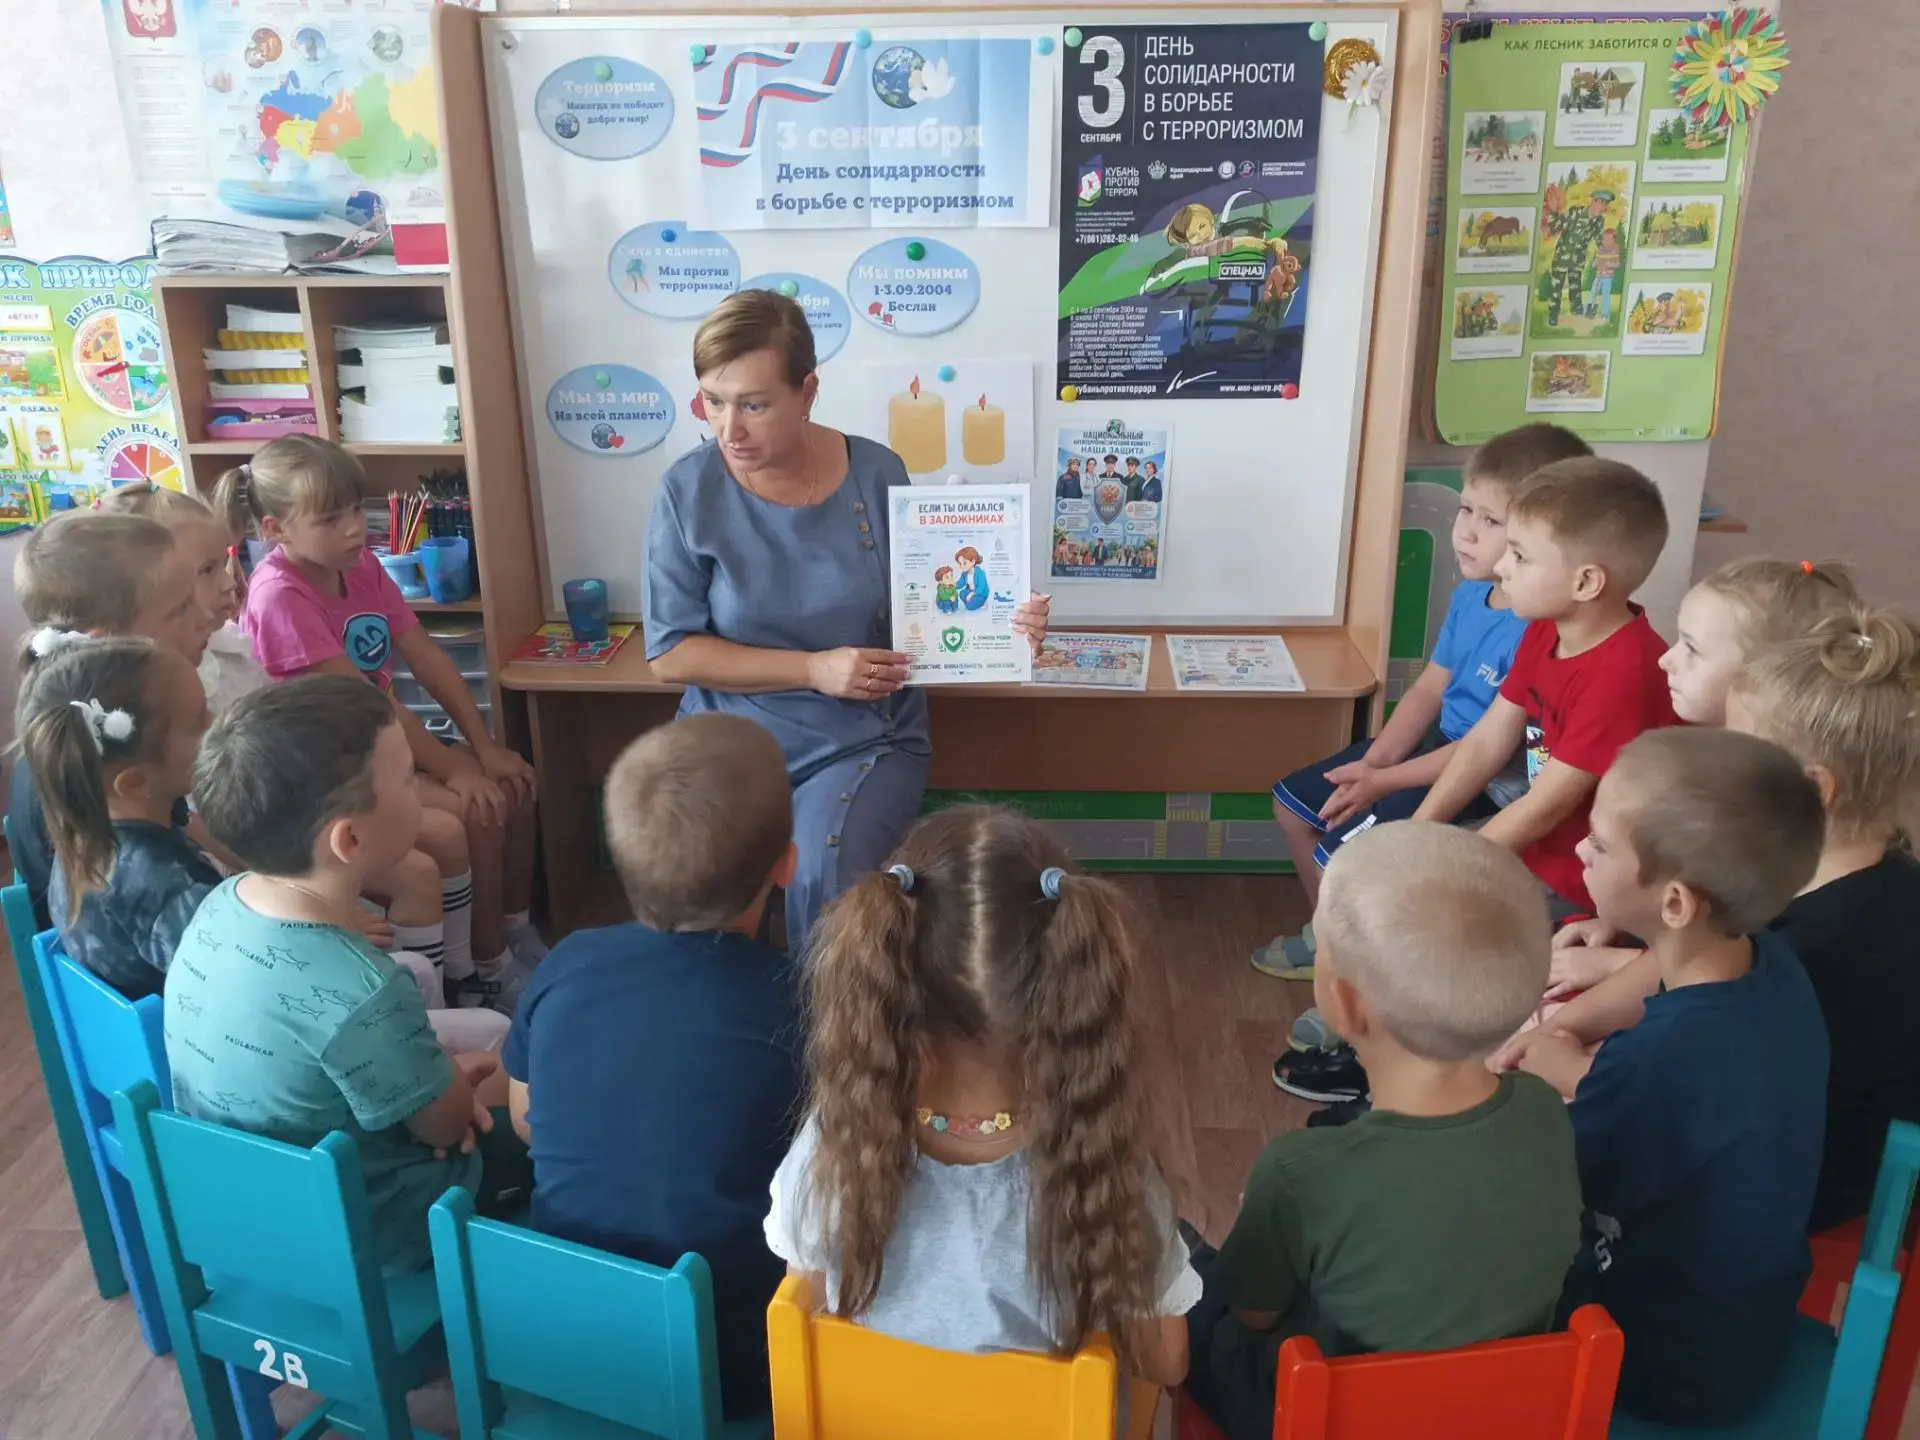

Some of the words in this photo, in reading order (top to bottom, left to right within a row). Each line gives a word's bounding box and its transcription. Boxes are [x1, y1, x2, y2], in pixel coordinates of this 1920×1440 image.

[1145, 36, 1194, 58] ДЕНЬ
[1504, 40, 1529, 50] КАК
[1534, 39, 1584, 50] ЛЕСНИК
[1588, 37, 1659, 49] ЗАБОТИТСЯ
[1662, 38, 1671, 48] О
[1144, 63, 1295, 86] СОЛИДАРНОСТИ
[563, 80, 656, 96] Терроризм
[1078, 36, 1125, 128] 3
[1144, 93, 1155, 112] В
[1161, 92, 1234, 112] БОРЬБЕ
[586, 114, 617, 125] добро
[626, 114, 649, 125] мир!
[1143, 121, 1154, 141] С
[1160, 119, 1304, 141] ТЕРРОРИЗМОМ
[776, 122, 797, 149] 3
[808, 117, 983, 157] сентября
[1080, 133, 1122, 143] СЕНТЯБРЯ
[776, 163, 830, 183] День
[836, 162, 986, 182] солидарности
[1105, 167, 1139, 176] КУБАНЬ
[1105, 177, 1139, 186] ПРОТИВ
[1105, 188, 1138, 196] ТЕРРОРА
[756, 197, 766, 210] в
[771, 192, 847, 215] борьбе
[853, 196, 865, 209] с
[870, 194, 1014, 214] терроризмом
[658, 266, 680, 276] Мы
[683, 267, 729, 279] против
[858, 266, 888, 280] Мы
[894, 267, 968, 281] помним
[1220, 265, 1264, 277] СПЕЦНАЗ
[659, 281, 733, 292] терроризма!
[874, 284, 952, 296] 1-3.09.2004
[67, 294, 116, 327] ВРЕМЯ
[124, 295, 160, 325] ГОД
[888, 301, 936, 312] Беслан
[558, 390, 590, 404] Мы
[596, 392, 616, 403] за
[621, 392, 659, 407] мир
[554, 411, 572, 421] На
[575, 410, 606, 421] всей
[609, 410, 667, 421] планете!
[1081, 446, 1107, 454] НАША
[1110, 446, 1144, 455] ЗАЩИТА
[919, 504, 940, 513] ЕСЛИ
[944, 504, 955, 512] ТЫ
[958, 503, 1004, 512] ОКАЗАЛСЯ
[920, 516, 927, 524] В
[929, 515, 1004, 525] ЗАЛОЖНИКАХ
